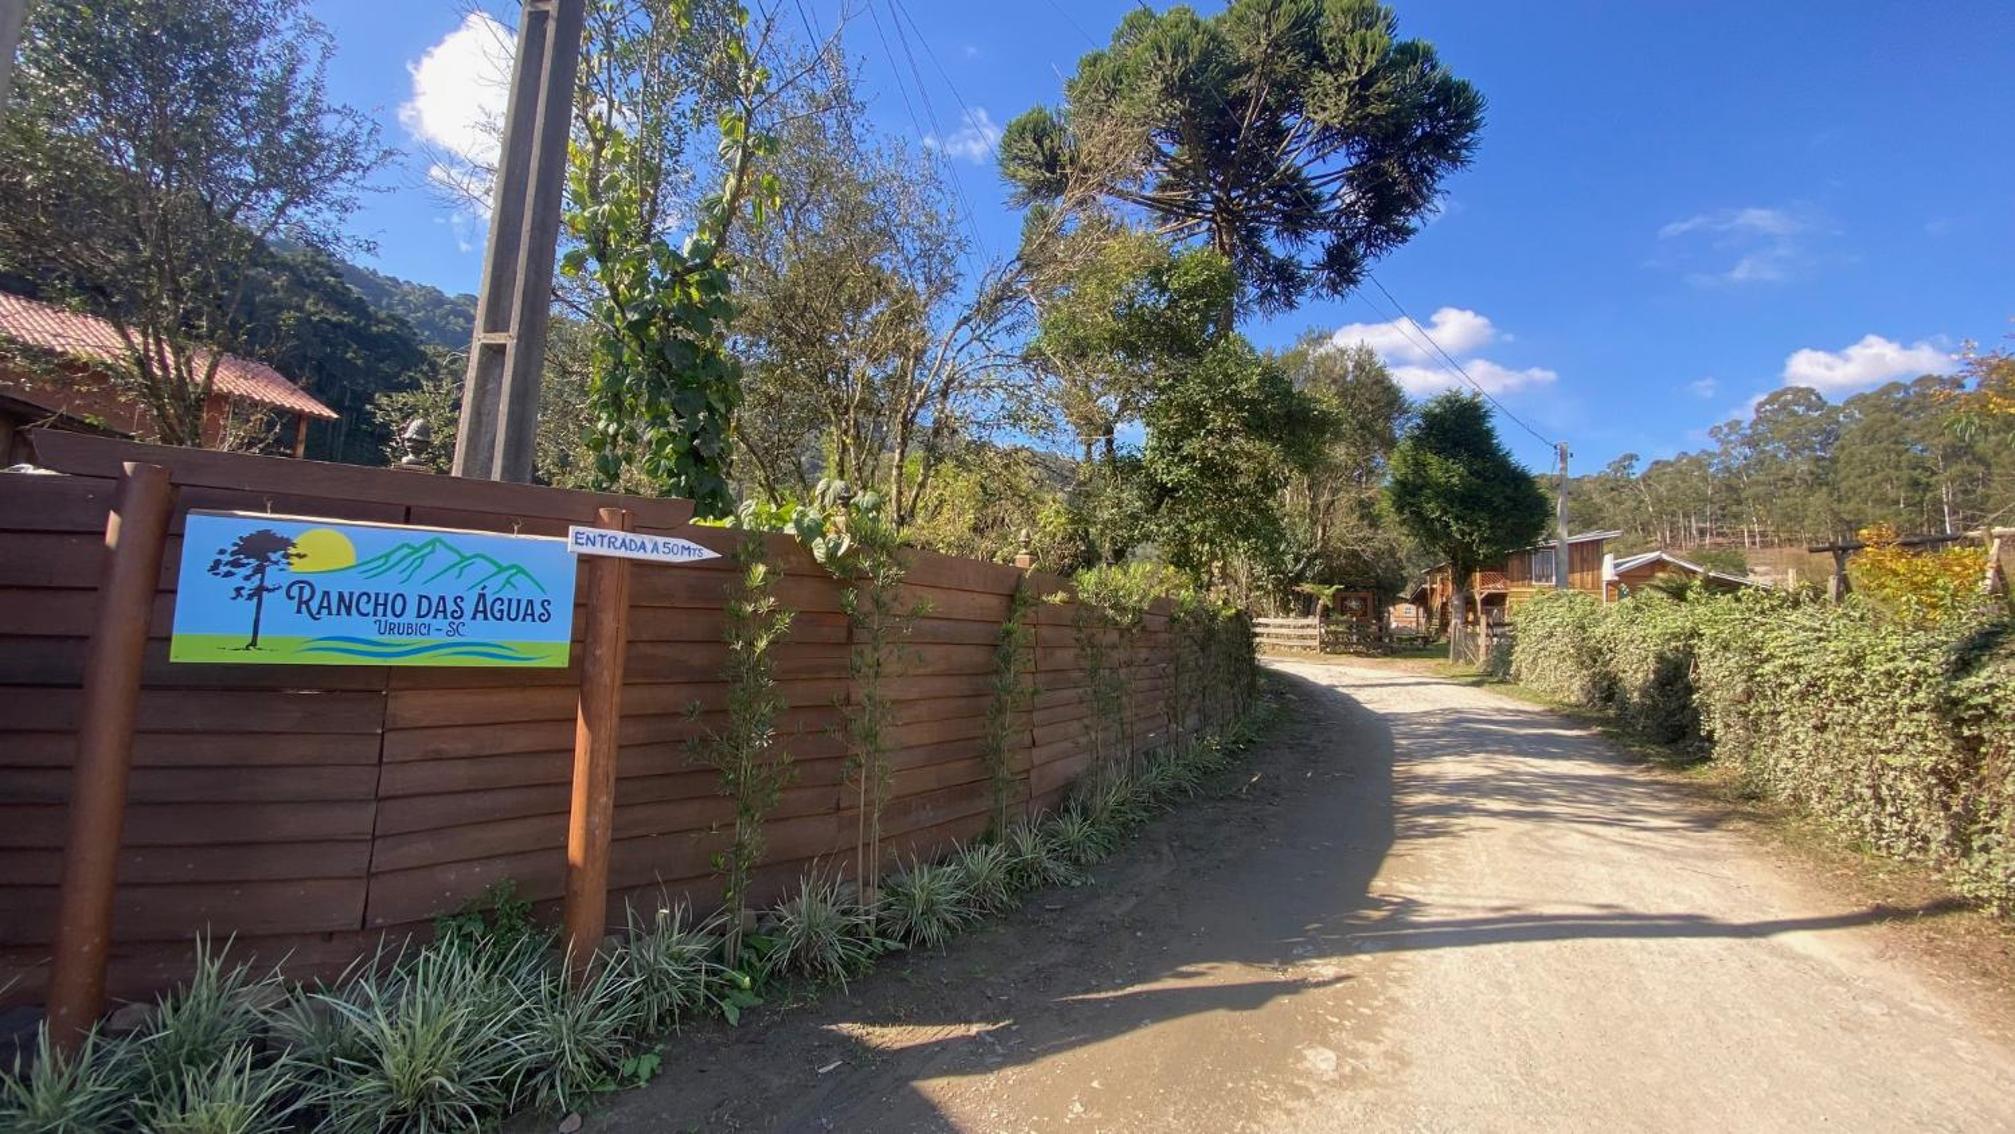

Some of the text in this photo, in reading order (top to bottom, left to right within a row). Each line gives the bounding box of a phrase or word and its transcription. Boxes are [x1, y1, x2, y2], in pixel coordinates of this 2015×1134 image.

[575, 532, 647, 553] ENTRADA
[285, 580, 552, 623] RANCHO DAS ÁGUAS
[374, 621, 431, 636] URUBICI
[446, 622, 467, 637] SC
